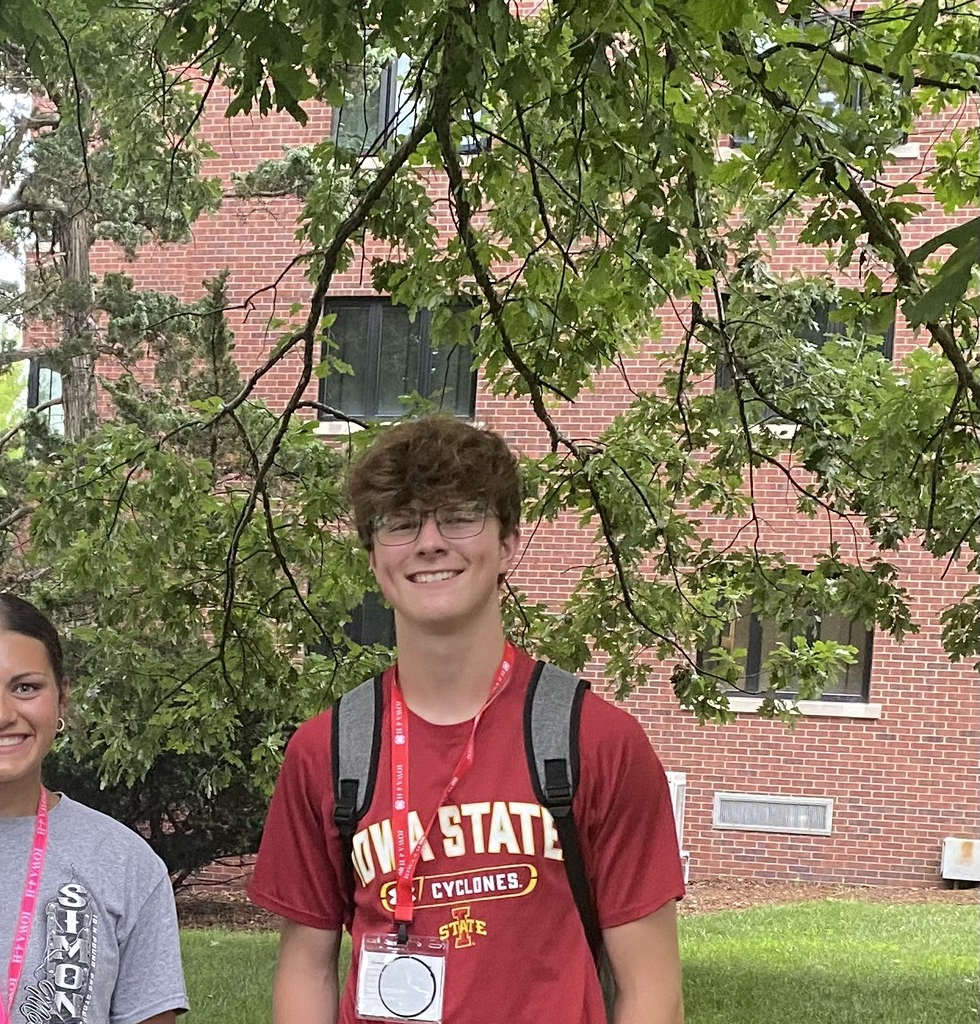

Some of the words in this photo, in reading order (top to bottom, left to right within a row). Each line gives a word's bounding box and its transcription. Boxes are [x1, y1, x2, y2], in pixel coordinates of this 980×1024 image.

[437, 801, 565, 862] STATE
[29, 848, 44, 878] IOWA
[15, 911, 31, 942] IOWA
[438, 919, 487, 940] STATE
